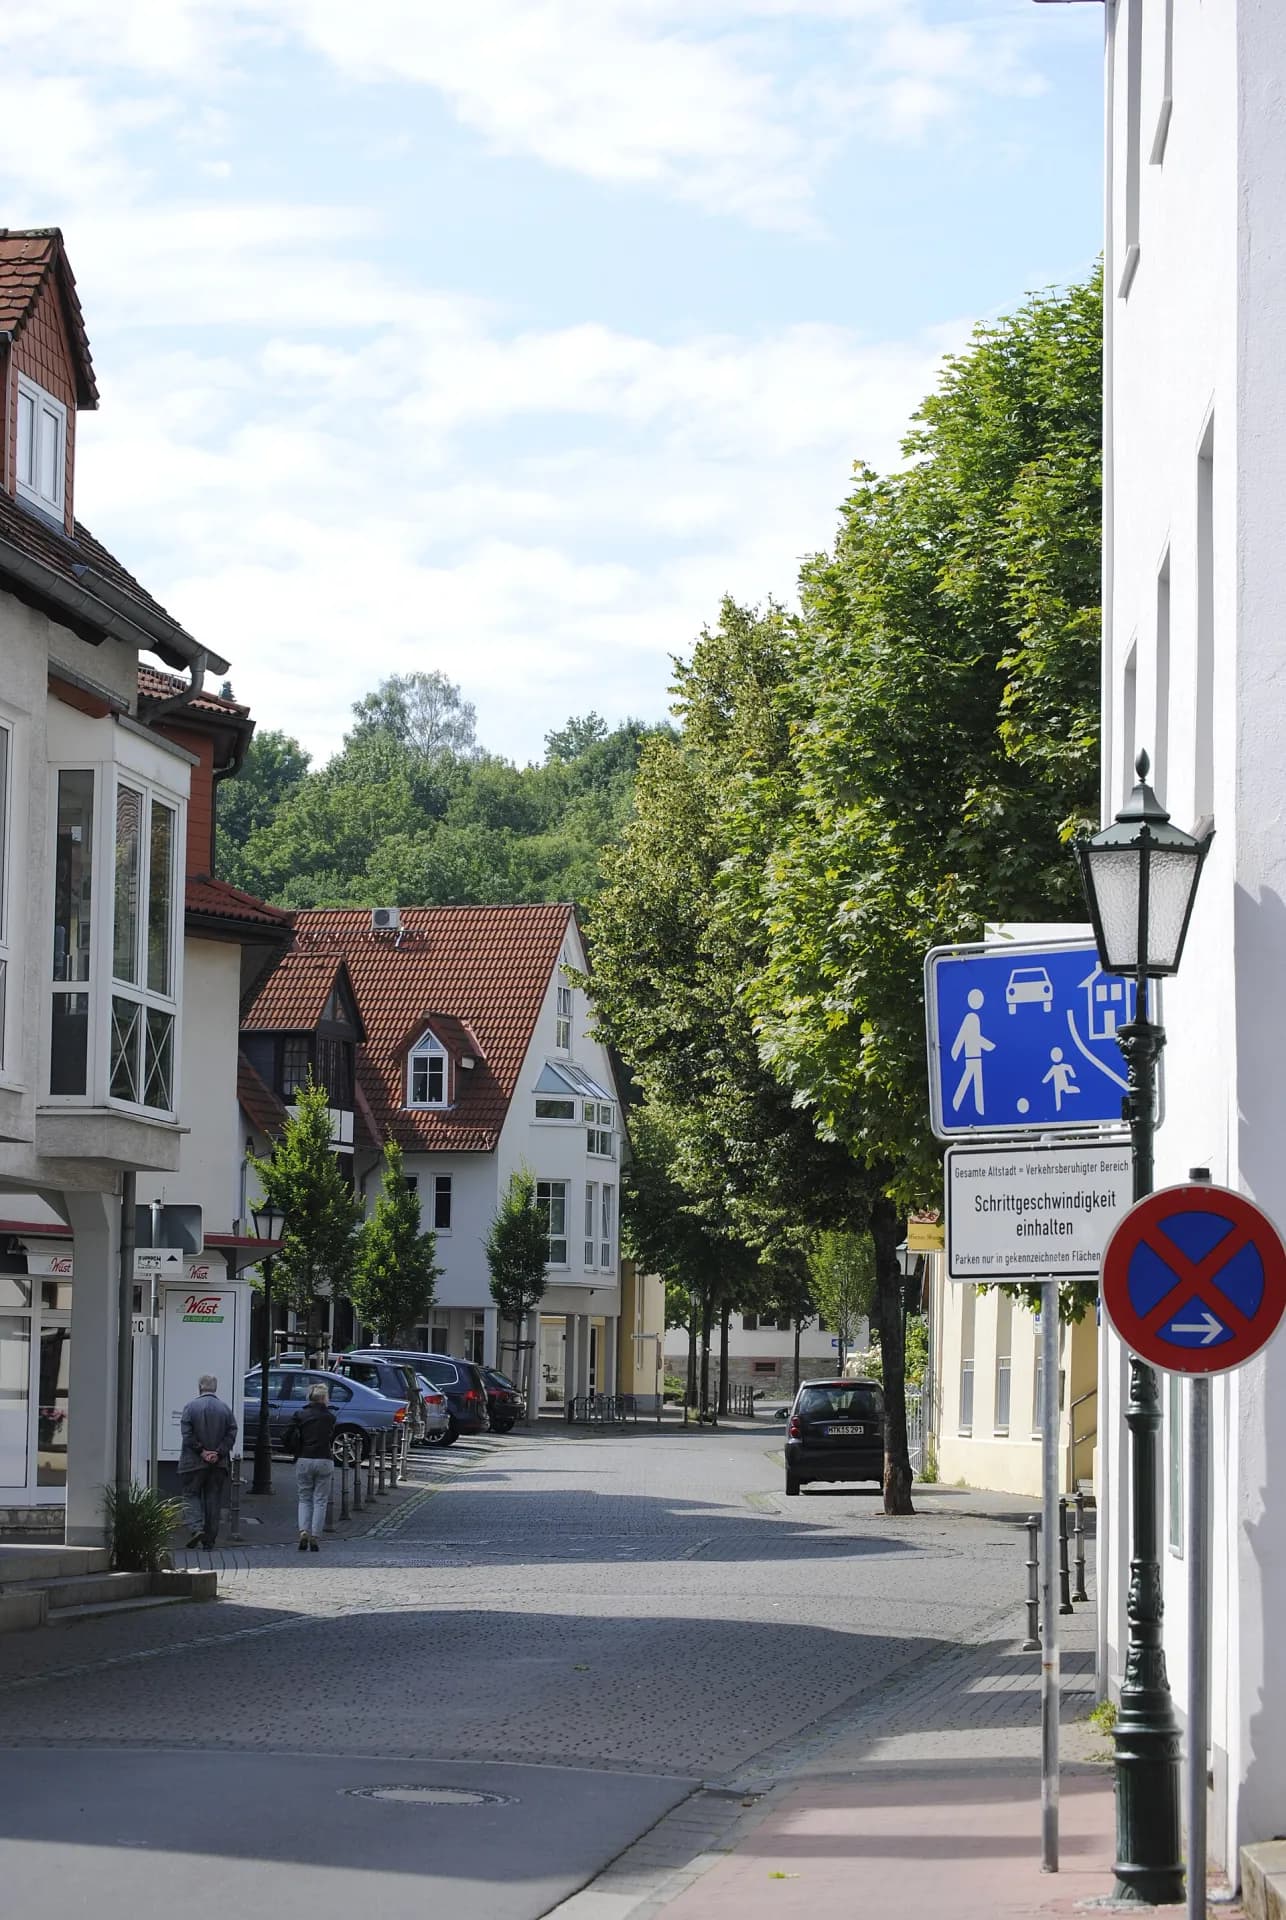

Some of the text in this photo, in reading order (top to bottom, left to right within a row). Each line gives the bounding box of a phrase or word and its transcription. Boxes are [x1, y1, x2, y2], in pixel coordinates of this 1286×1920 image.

[955, 1166, 986, 1178] Gesamte
[987, 1164, 1017, 1177] Altstadt
[1026, 1161, 1097, 1176] Verkehrsberuhigter
[1100, 1160, 1129, 1173] Bereich
[974, 1188, 1117, 1216] Schrittgeschwindigkeit
[1016, 1218, 1073, 1237] einhalten
[955, 1250, 1101, 1266] Parken nur in gekennzeichneten Flächen
[189, 1264, 210, 1280] Wüst
[184, 1295, 222, 1315] Wüst
